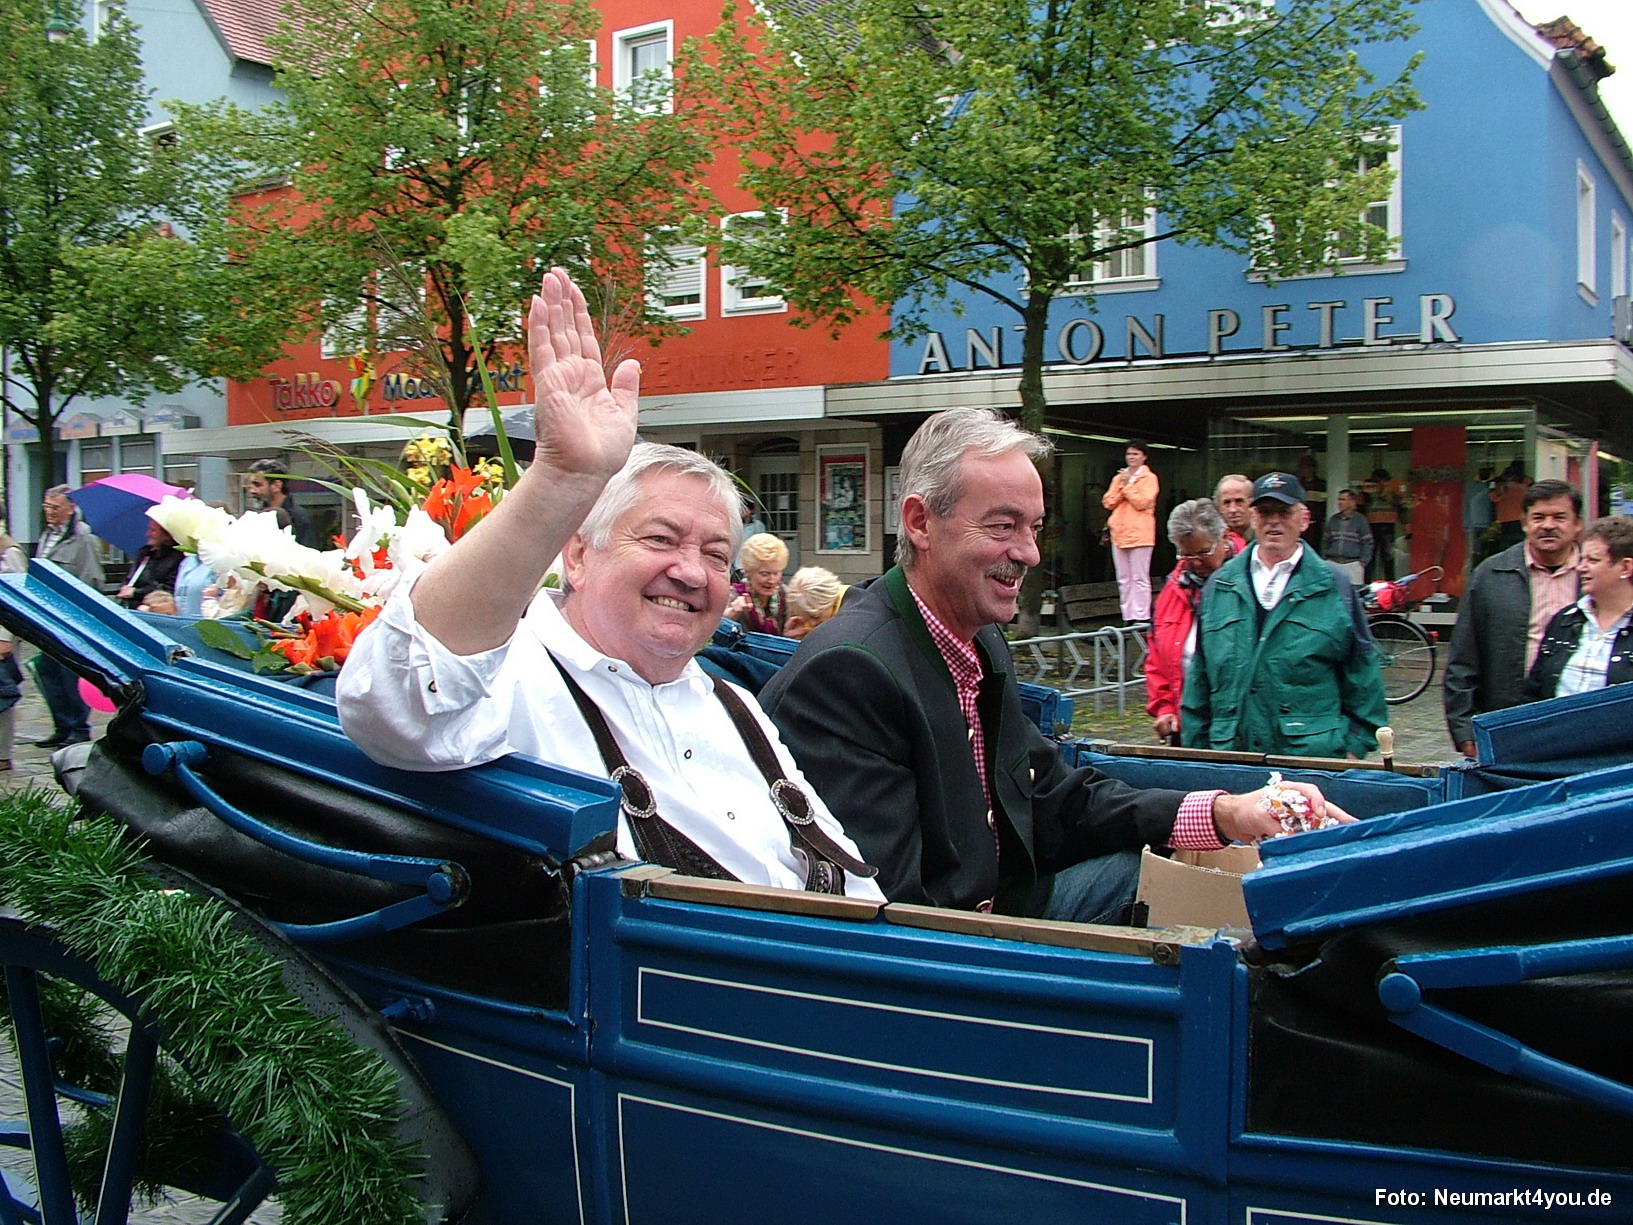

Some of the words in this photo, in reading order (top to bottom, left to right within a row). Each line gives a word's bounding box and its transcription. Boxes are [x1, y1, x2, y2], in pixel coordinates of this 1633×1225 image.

[918, 313, 1165, 375] ANON
[1207, 293, 1461, 354] PETER
[268, 372, 343, 410] Takko
